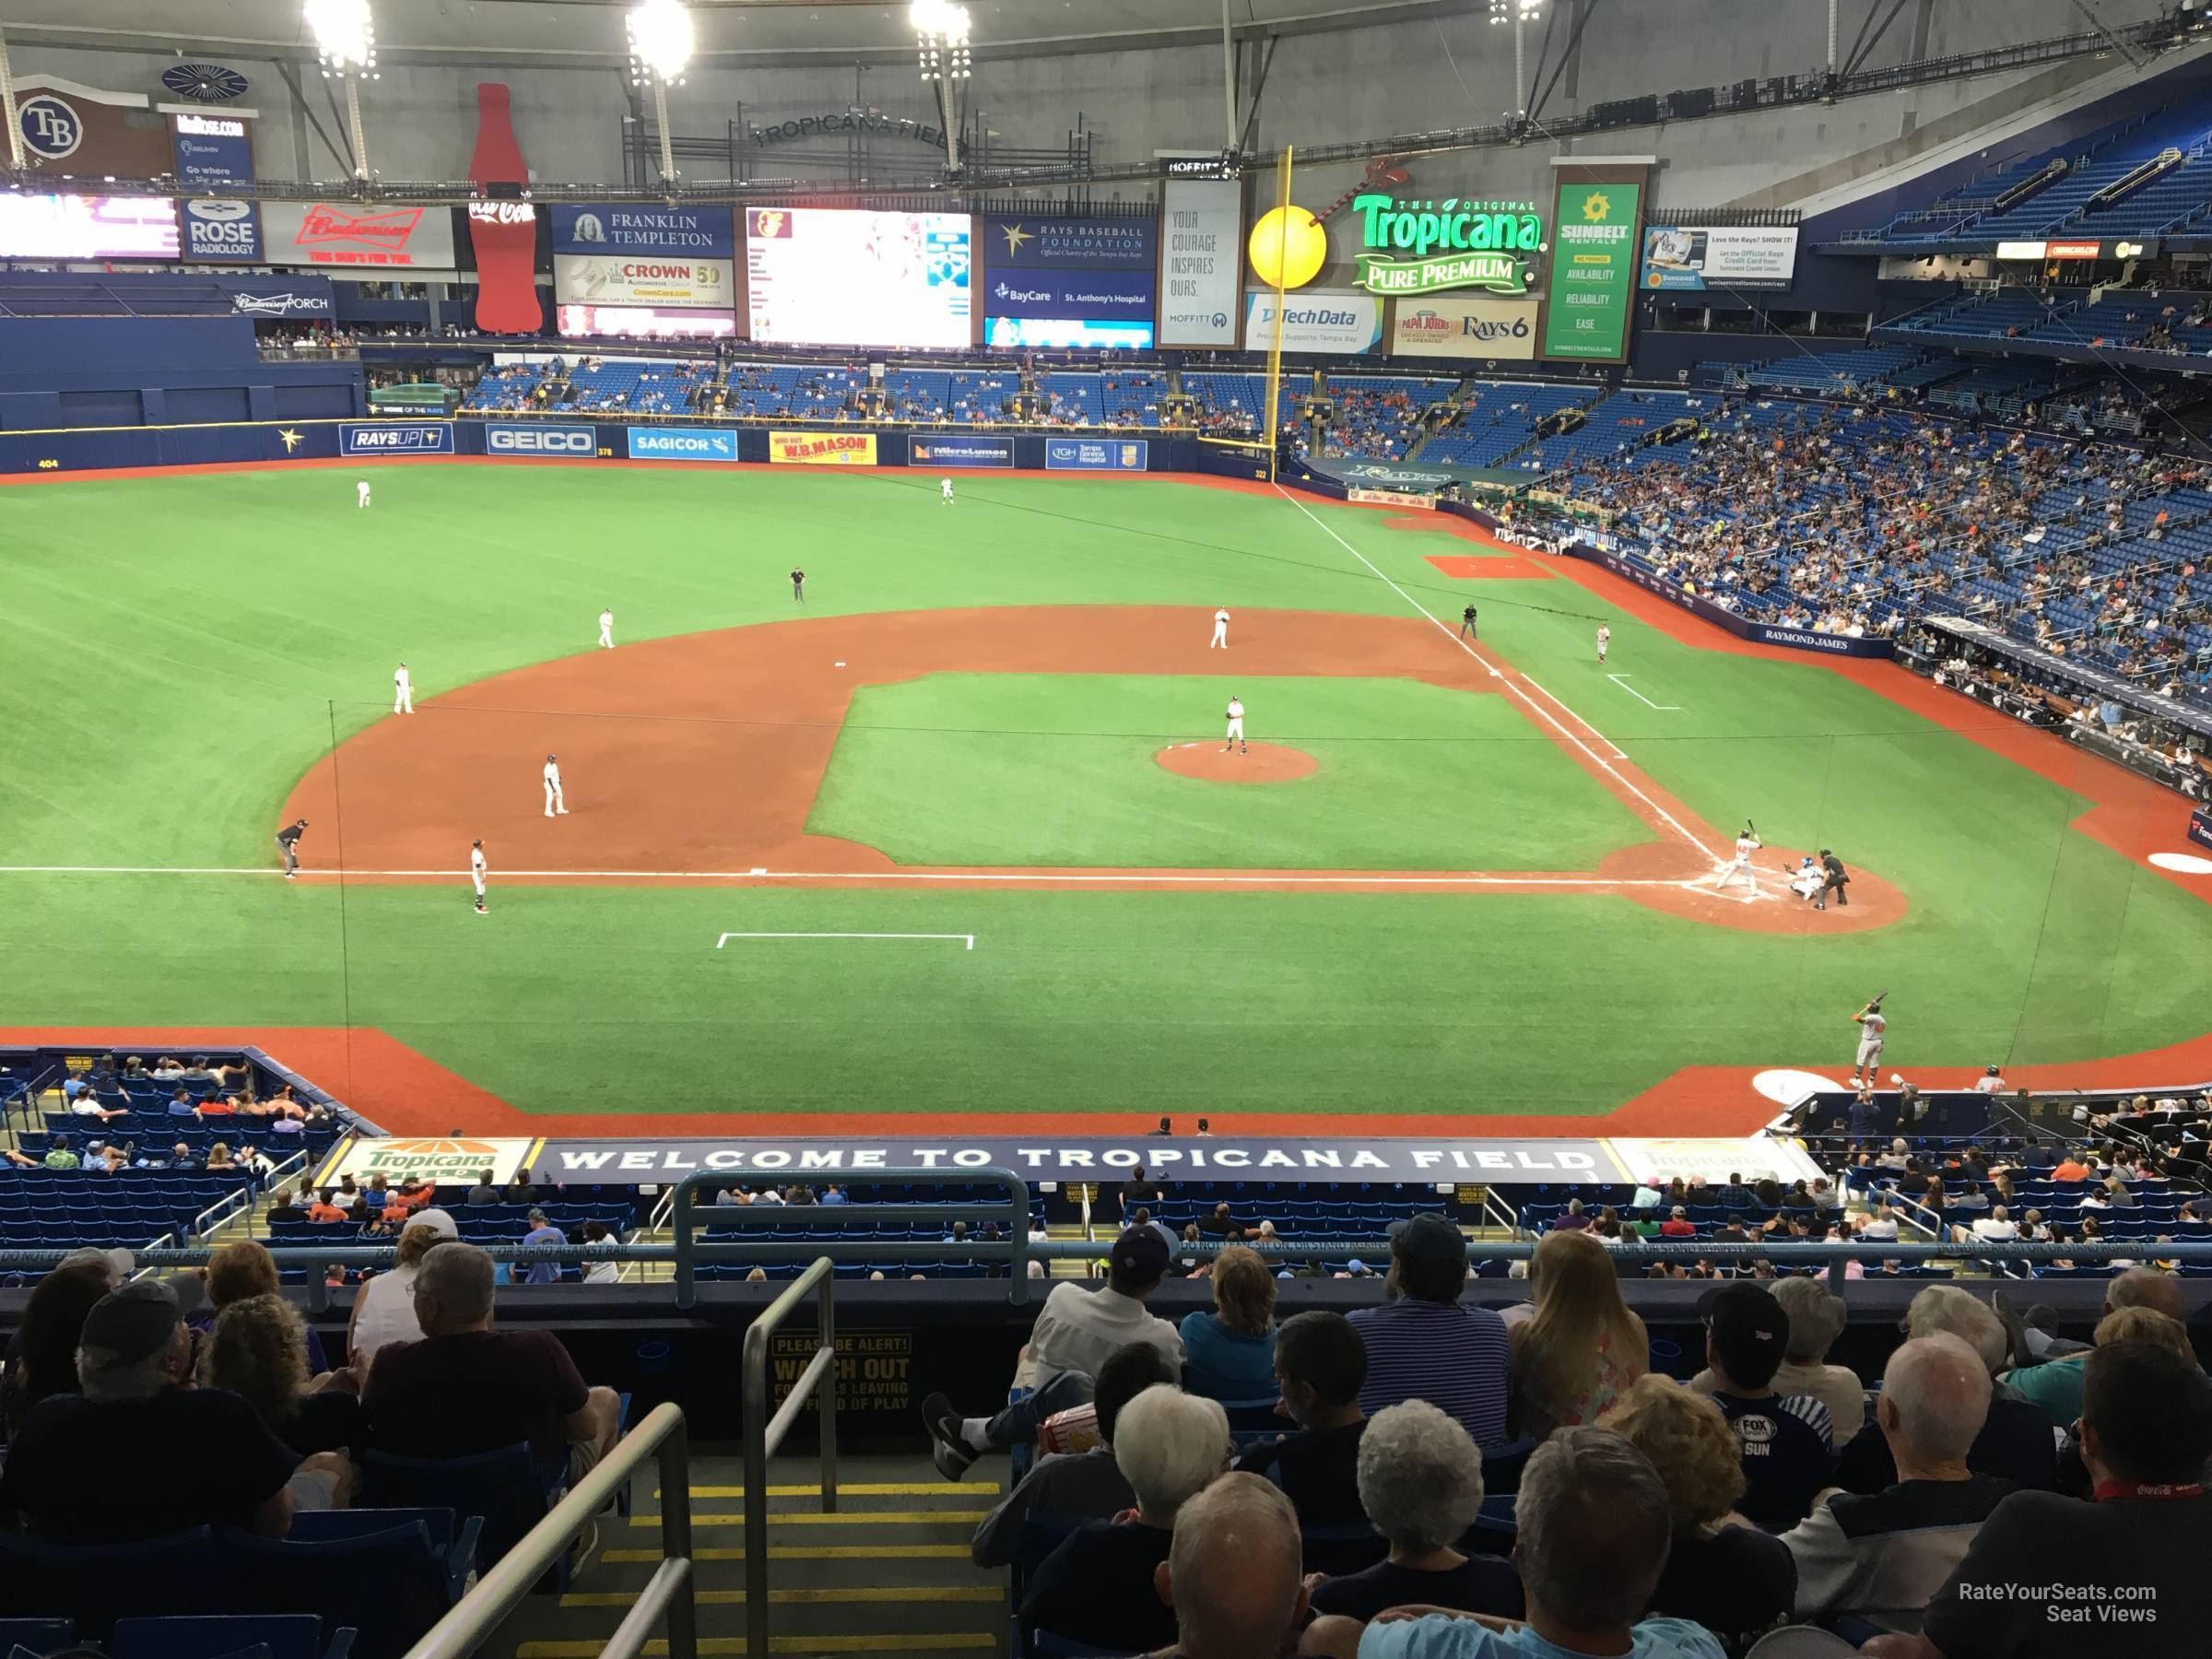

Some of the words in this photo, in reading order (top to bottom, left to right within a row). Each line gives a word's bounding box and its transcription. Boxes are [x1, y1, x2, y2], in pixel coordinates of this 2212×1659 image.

[749, 114, 893, 147] TROPICANA
[186, 166, 199, 174] Go
[202, 167, 230, 175] where
[1400, 201, 1432, 209] THE
[1464, 201, 1535, 211] ORIGINAL
[612, 214, 697, 229] FRANKLIN
[1172, 211, 1197, 229] YOUR
[1353, 194, 1542, 254] Tropicana
[190, 222, 254, 243] ROSE
[612, 230, 713, 246] TEMPLETON
[1041, 226, 1073, 235] RAYS
[1079, 227, 1143, 237] BASEBALL
[1561, 225, 1629, 239] SUNBELT
[193, 242, 254, 254] RADIOLOGY
[1041, 238, 1142, 249] FOUNDATION
[1171, 234, 1216, 252] COURAGE
[622, 264, 690, 279] CROWN
[1171, 257, 1214, 275] INSPIRES
[1369, 265, 1418, 288] PURE
[1422, 259, 1513, 285] PREMIUM
[1567, 270, 1615, 281] AVAILABILITY
[1010, 290, 1051, 302] BayCare
[1065, 294, 1076, 302] St.
[1077, 294, 1113, 305] Anthony's
[1115, 294, 1146, 305] Hospital
[1567, 293, 1610, 305] RELIABILITY
[288, 298, 327, 310] PORCH
[1170, 314, 1209, 323] MOFFITT
[1401, 317, 1422, 330] PAPA
[1576, 319, 1594, 329] EASE
[1512, 317, 1529, 337] 6
[1257, 333, 1283, 341] Proudy
[1285, 334, 1317, 342] Supports
[1319, 335, 1343, 343] Tampa
[1345, 335, 1358, 344] Bay
[490, 430, 592, 451] GEICO
[637, 437, 709, 451] SAGICOR
[39, 460, 58, 468] 404
[1255, 469, 1266, 478] 322
[1765, 629, 1815, 644] RAYMOND
[1815, 638, 1848, 650] JAMES
[369, 1151, 496, 1169] Tropicana
[559, 1148, 888, 1170] WELCOME
[912, 1148, 992, 1168] TO
[1018, 1148, 1388, 1169] TROPICANA
[1410, 1148, 1595, 1171] FIELD
[2, 1251, 18, 1261] DO
[19, 1251, 46, 1261] NOT
[146, 1251, 178, 1261] STAND
[516, 1246, 553, 1256] STAND
[555, 1245, 600, 1255] AGAINST
[605, 1245, 630, 1255] RAIL
[778, 1339, 820, 1351] PLEAS
[836, 1338, 853, 1351] BE
[858, 1338, 907, 1351] ALERT!
[774, 1359, 855, 1381] WACH
[865, 1358, 910, 1380] OUT
[852, 1382, 908, 1394] LEAVING
[852, 1397, 868, 1410] OF
[875, 1396, 909, 1410] PLAY
[1743, 1420, 1767, 1431] FOX
[1745, 1442, 1770, 1456] SUN
